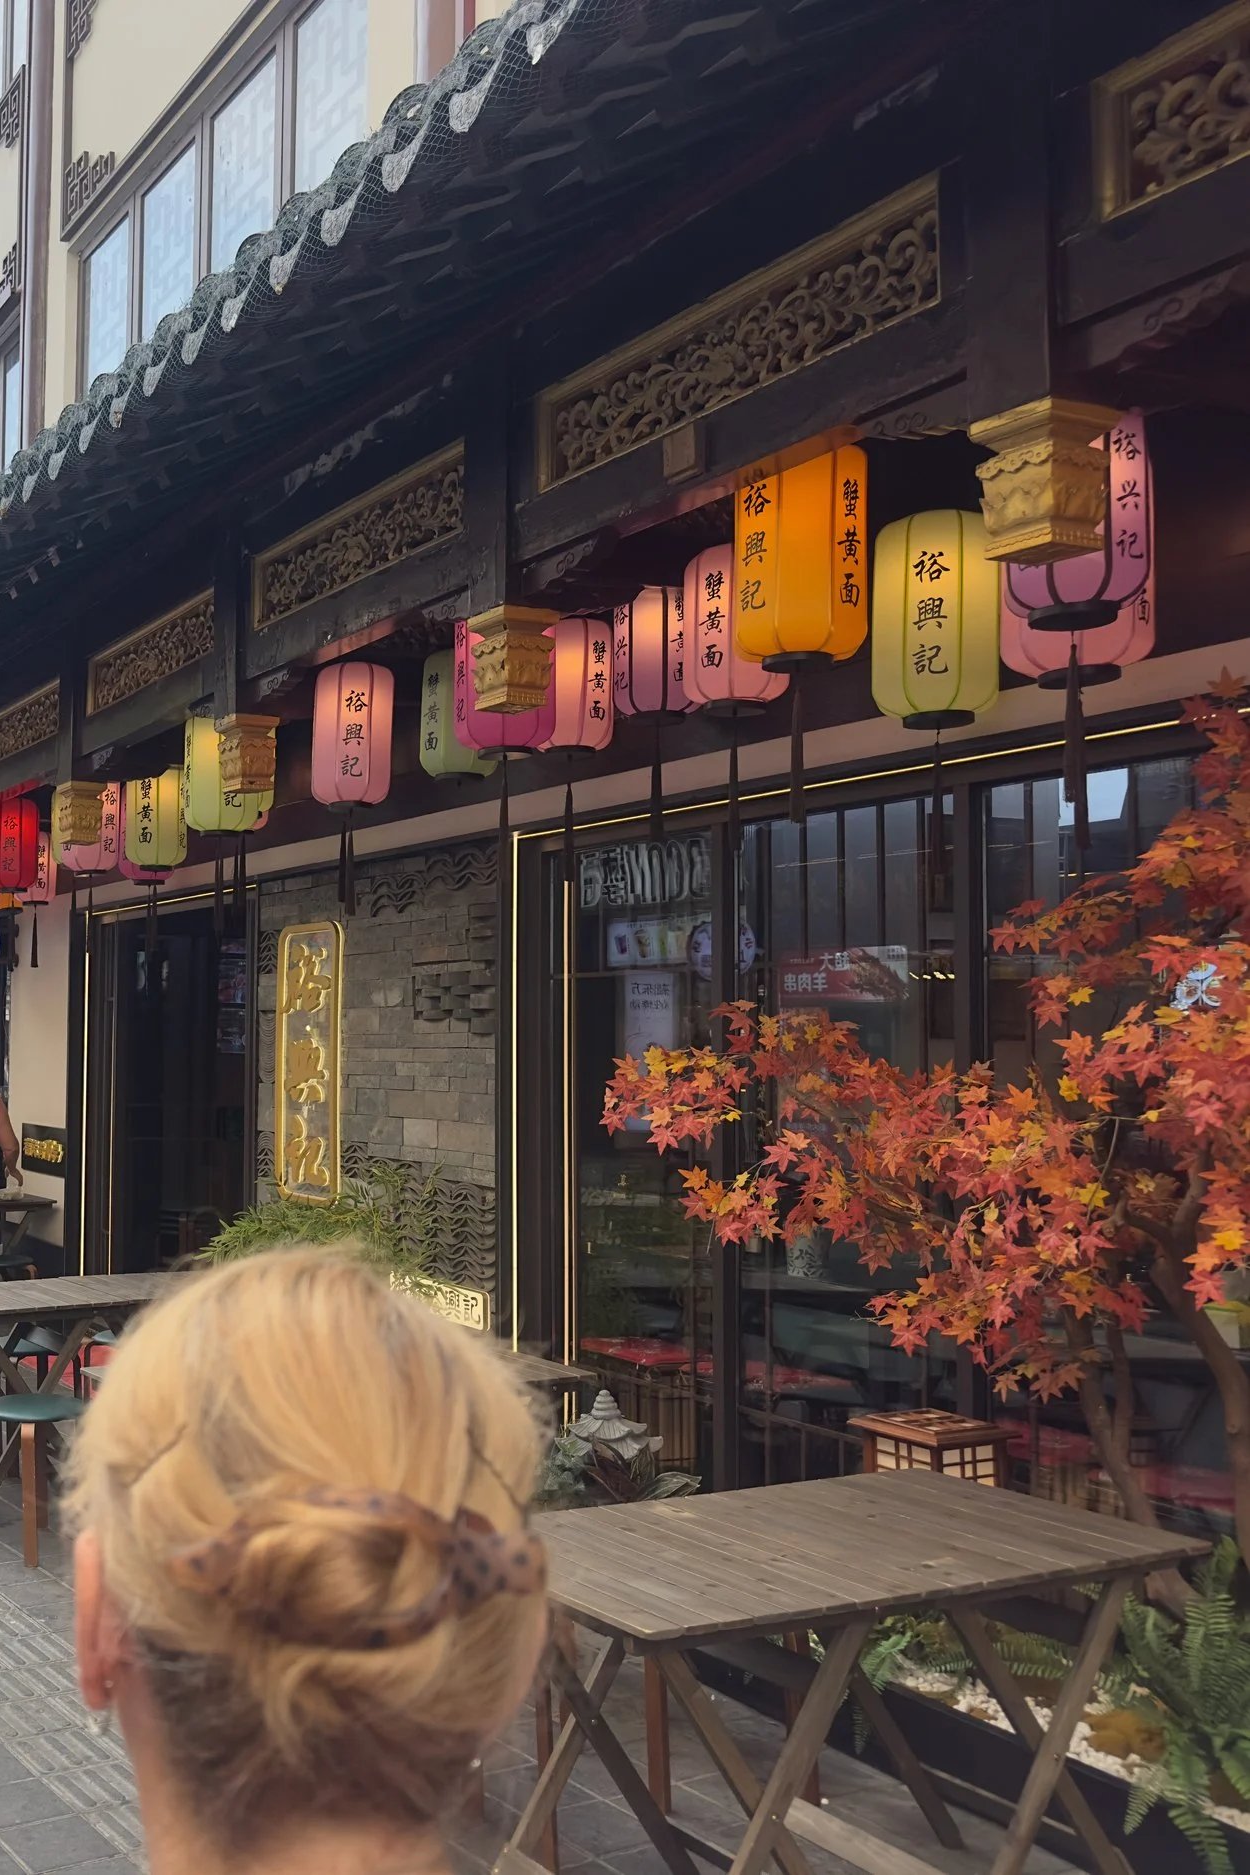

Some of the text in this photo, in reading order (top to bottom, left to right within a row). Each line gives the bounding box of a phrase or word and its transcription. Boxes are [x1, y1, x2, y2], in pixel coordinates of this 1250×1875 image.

[1111, 428, 1145, 560] 裕兴记
[740, 483, 772, 613] 裕興記
[836, 477, 862, 609] 蟹黄面
[614, 604, 630, 692] 裕兴记
[698, 571, 726, 669] 蟹黄面
[911, 550, 951, 676] 裕興記
[423, 671, 440, 751] 蟹黄面
[587, 639, 608, 722] 蟹黄面
[339, 689, 368, 779] 裕興記
[2, 815, 19, 873] 裕興記
[103, 788, 117, 854] 裕興記
[136, 778, 154, 844] 蟹黄面
